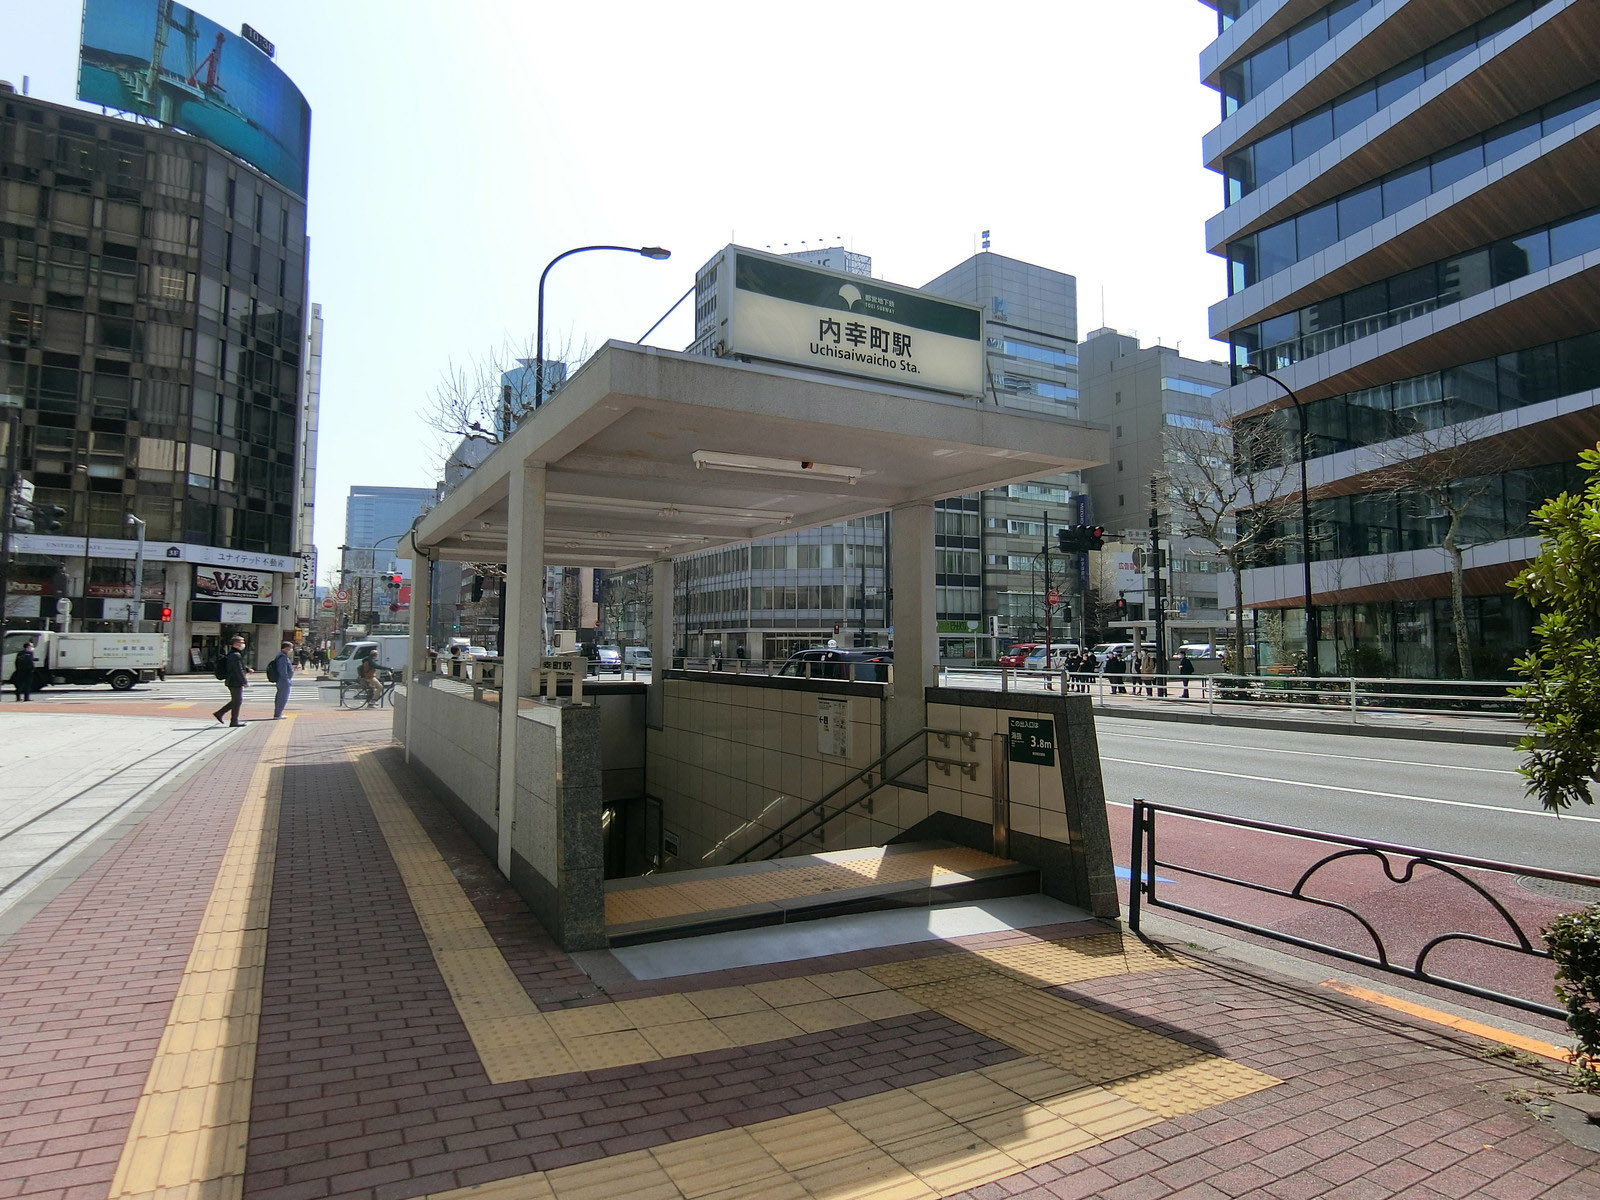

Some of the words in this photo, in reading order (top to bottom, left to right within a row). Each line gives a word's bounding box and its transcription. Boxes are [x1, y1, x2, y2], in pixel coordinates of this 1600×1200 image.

[248, 28, 273, 53] 10:36
[819, 317, 912, 359] 内幸町駅
[810, 342, 897, 369] Uchisaiwaicho
[899, 359, 921, 374] Sta.
[217, 553, 285, 567] ユナイテッド不動産
[213, 571, 259, 592] VOLKS
[301, 554, 312, 591] やきとり
[1010, 720, 1039, 729] この出入口は
[1030, 735, 1052, 749] 3.8m
